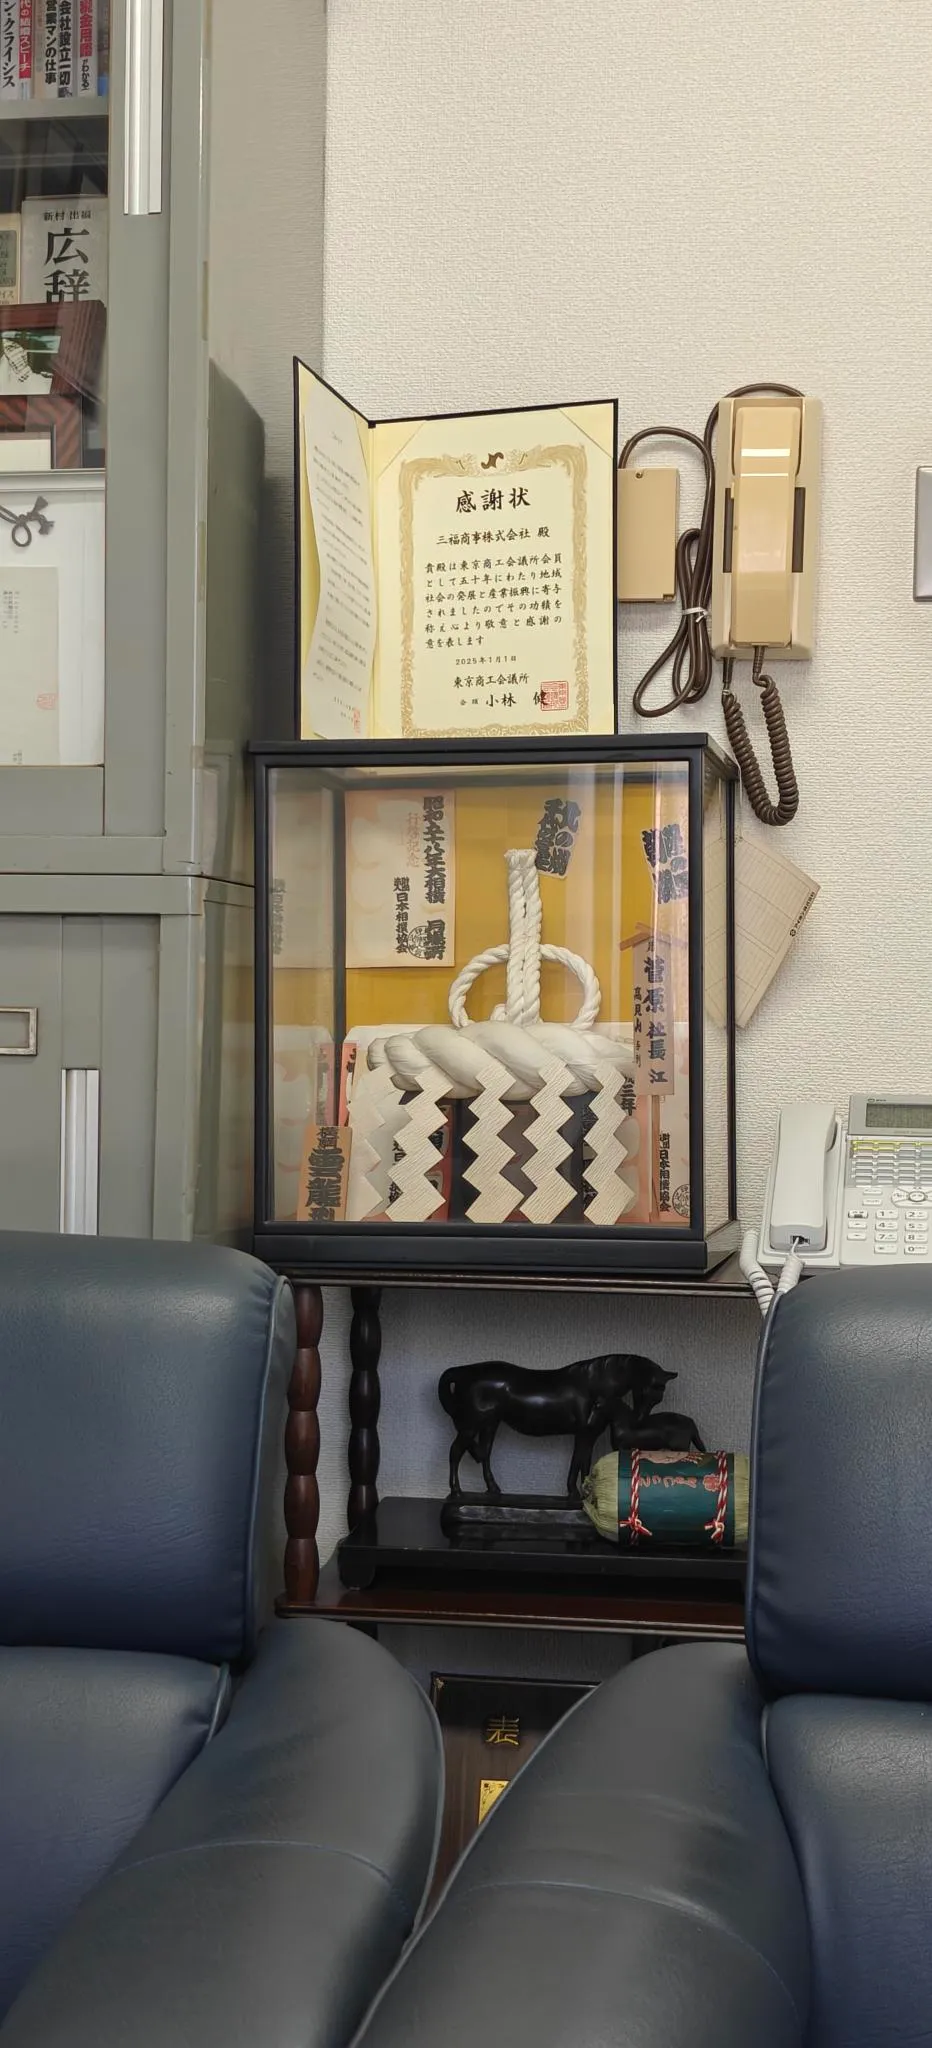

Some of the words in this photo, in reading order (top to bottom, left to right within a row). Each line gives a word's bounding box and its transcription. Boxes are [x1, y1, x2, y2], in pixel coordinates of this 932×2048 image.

[44, 227, 90, 303] 広辞
[456, 487, 531, 513] 感謝状
[436, 527, 531, 545] 三福商事株式会社
[537, 526, 550, 538] 殿
[424, 552, 562, 574] 貴殿は東京商工会議所会員
[426, 567, 562, 588] として五十年にわたり地域
[425, 583, 562, 603] 社会の発展と産業振興に寄与
[426, 599, 562, 618] されましたのでその功績を
[425, 615, 562, 633] 称え心より敬意と感謝の
[425, 635, 484, 649] 意を表します
[455, 655, 517, 665] 2025年1月1日
[453, 672, 530, 688] 東京商工会議所
[485, 692, 517, 707] 小林
